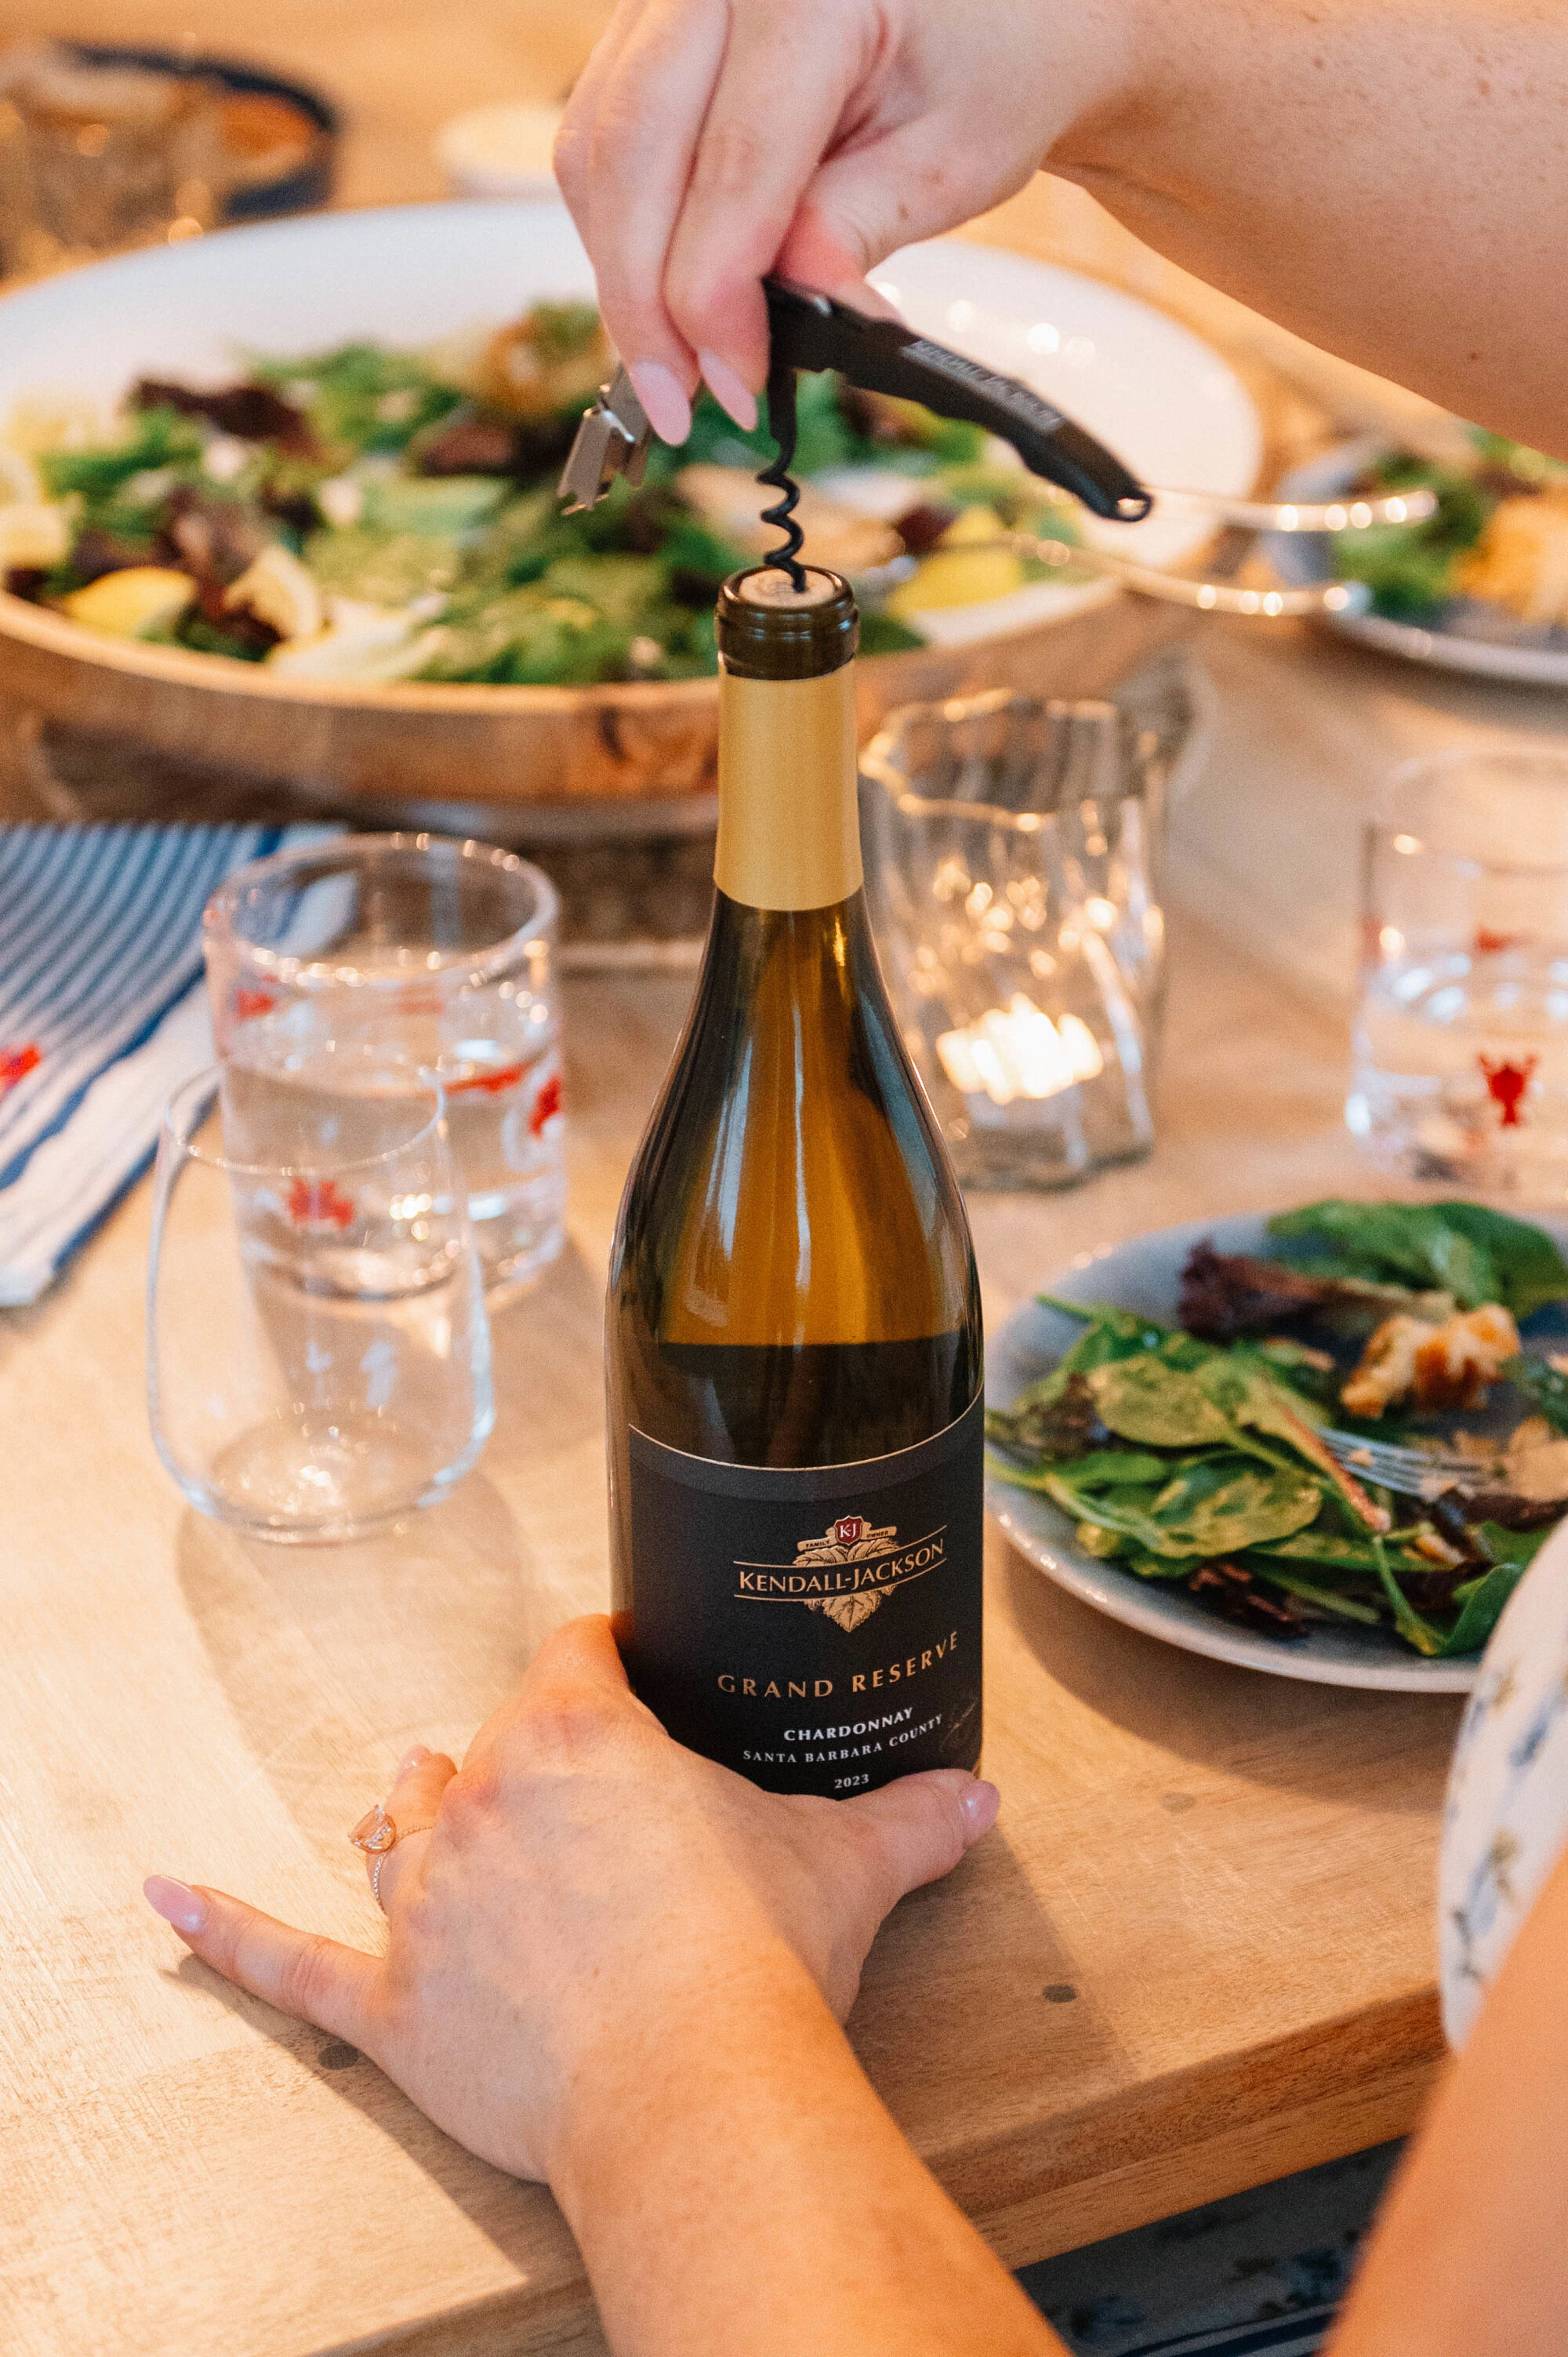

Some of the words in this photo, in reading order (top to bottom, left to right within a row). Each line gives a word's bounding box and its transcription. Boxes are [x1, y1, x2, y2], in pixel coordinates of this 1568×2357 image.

[805, 1540, 830, 1549] FAMILY
[840, 1524, 857, 1538] K-J
[739, 1538, 944, 1593] KENDALL-JACKSON
[717, 1675, 833, 1698] GRAND
[852, 1631, 958, 1692] RESERVE
[743, 1750, 797, 1763] SANTA
[805, 1742, 883, 1763] BARBARA
[889, 1714, 943, 1747] COUNTY
[784, 1707, 913, 1741] CHARDONNAY
[834, 1774, 869, 1789] 2023
